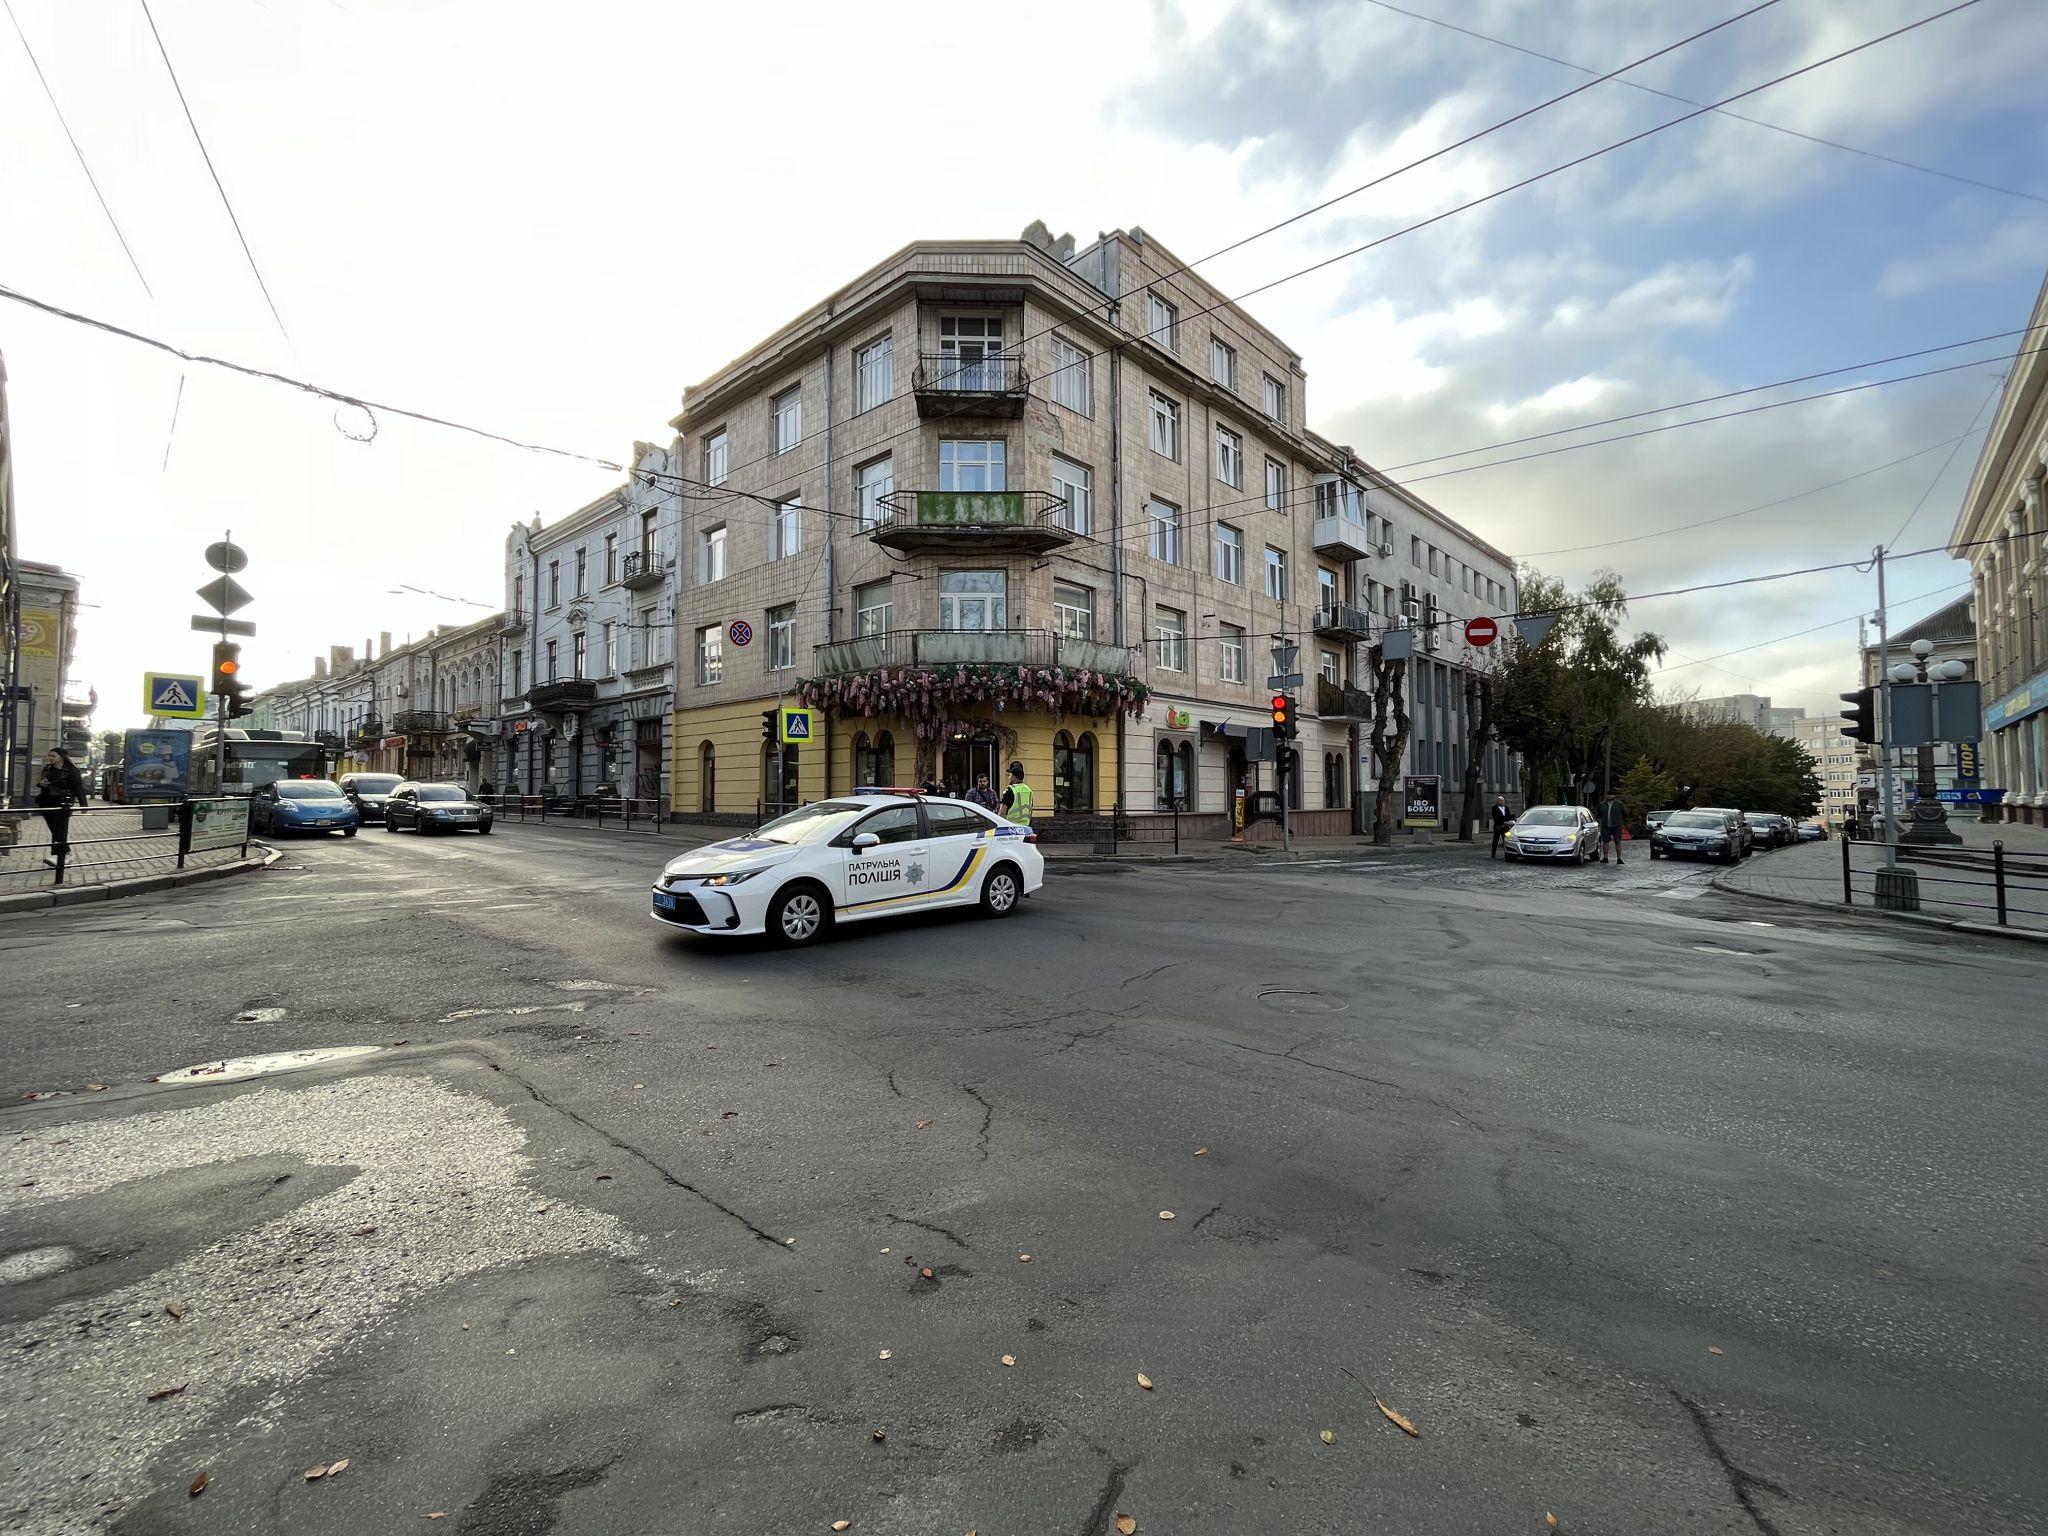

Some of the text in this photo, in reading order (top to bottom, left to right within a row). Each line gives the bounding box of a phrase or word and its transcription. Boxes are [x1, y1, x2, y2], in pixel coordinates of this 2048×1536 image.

[1961, 743, 1975, 777] СПОР
[1407, 805, 1435, 813] БОБУЛ
[848, 859, 901, 872] ПАТРУЛЬНА
[848, 869, 901, 886] ПОЛІЦІЯ
